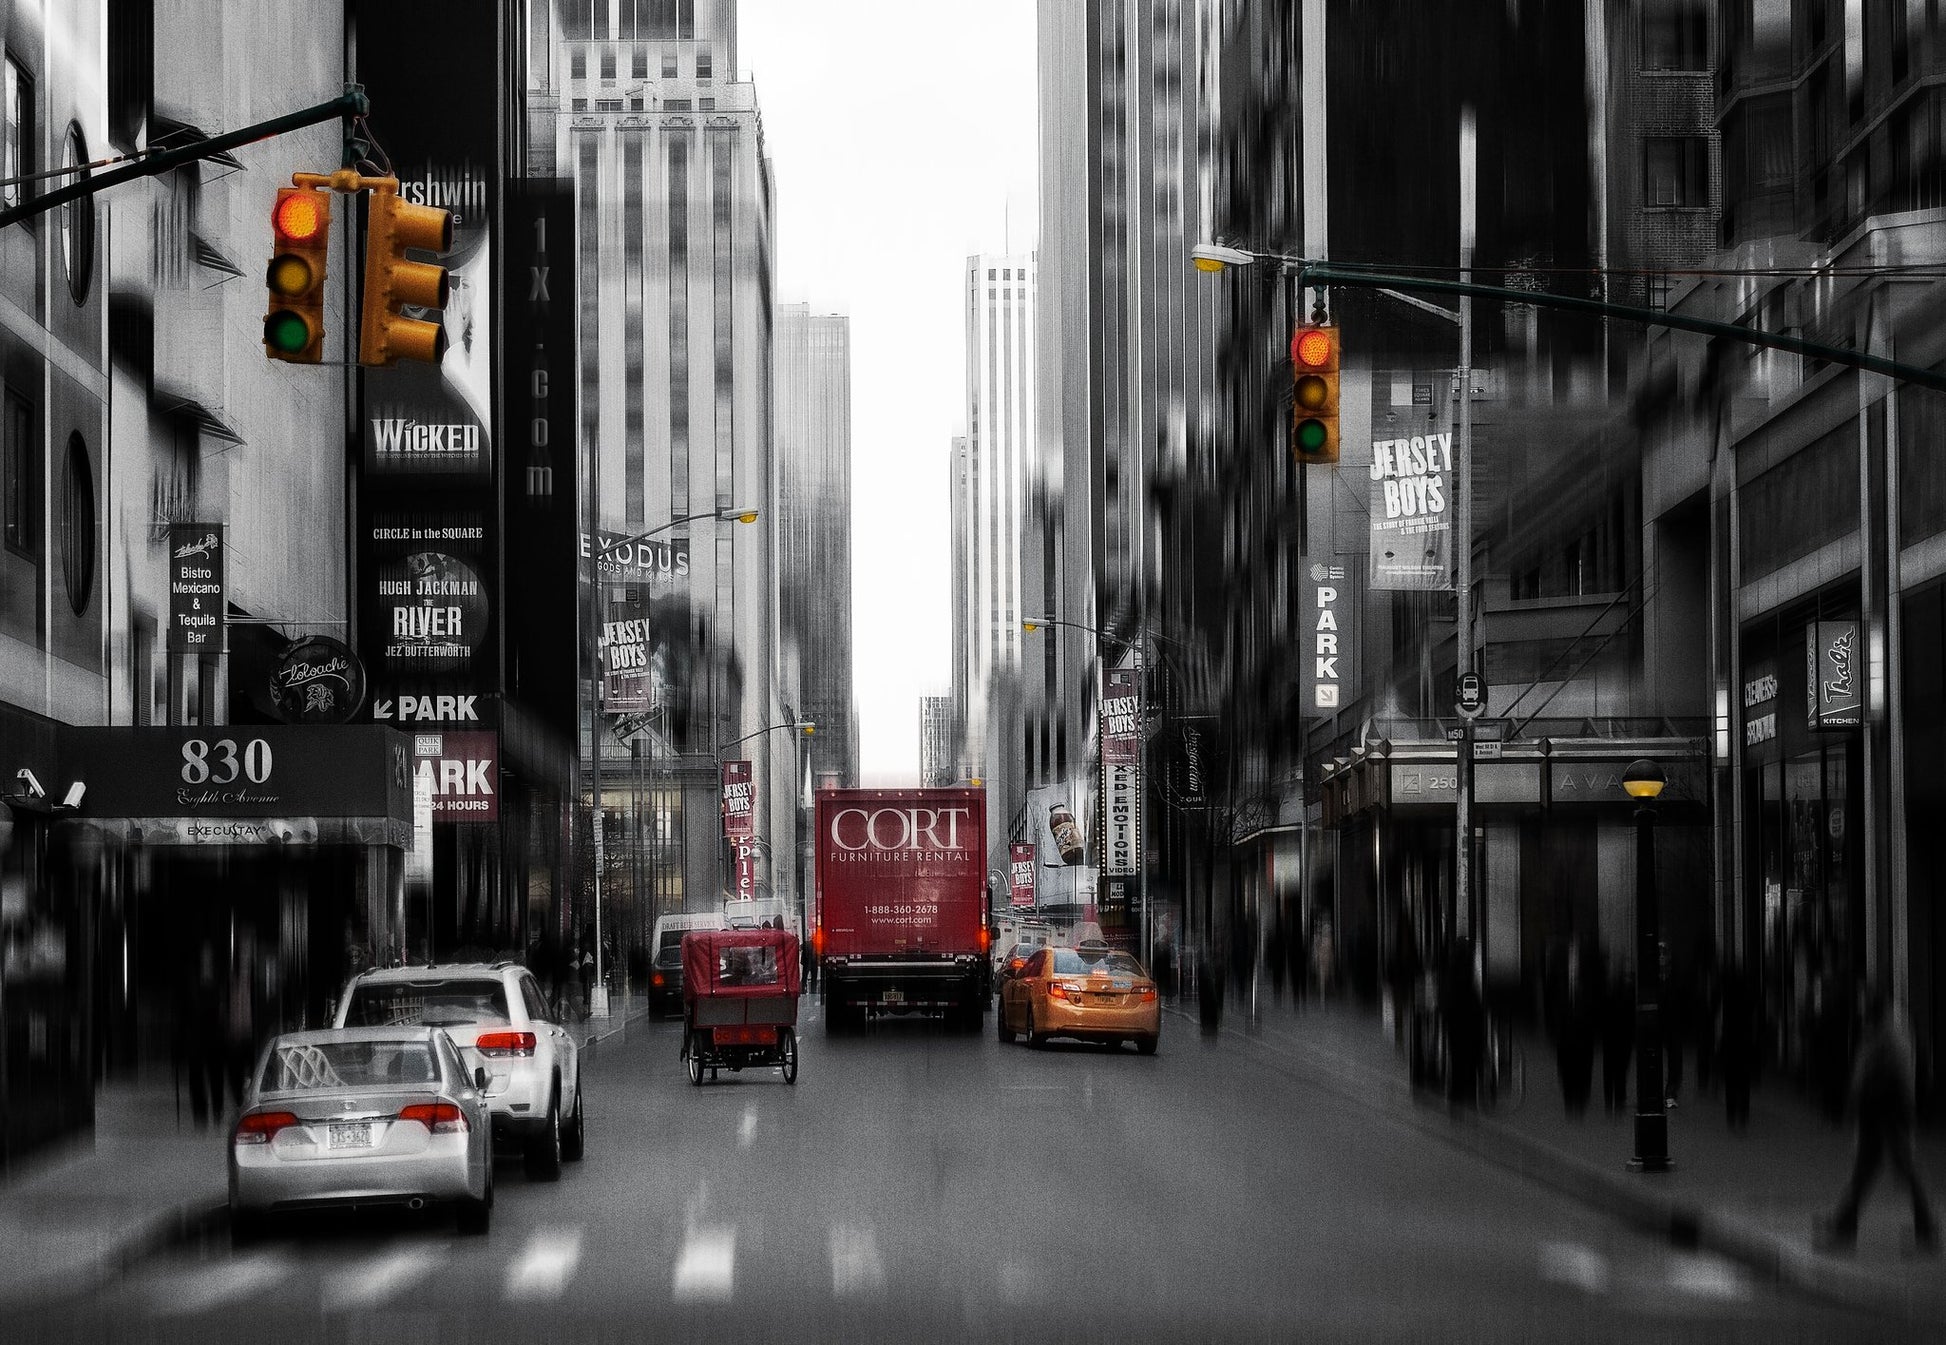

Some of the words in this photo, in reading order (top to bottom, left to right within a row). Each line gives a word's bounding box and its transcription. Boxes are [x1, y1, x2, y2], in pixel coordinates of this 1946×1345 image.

[392, 172, 486, 206] rshwin
[1370, 433, 1452, 481] JERSEY
[1383, 474, 1446, 518] BOYS
[373, 528, 410, 540] CIRCLE
[412, 528, 422, 539] in
[424, 528, 440, 539] the
[442, 527, 483, 540] SQUARE
[580, 532, 689, 576] EXODUS
[181, 567, 212, 579] Bistro
[598, 561, 620, 573] GODS
[173, 582, 220, 594] Mexicano
[379, 581, 411, 595] HUGH
[416, 581, 478, 596] JACKMAN
[193, 598, 201, 610] &
[178, 614, 216, 628] Tequila
[394, 606, 462, 636] RIVER
[187, 632, 207, 643] Bar
[602, 618, 650, 646] JERSEY
[1316, 587, 1339, 678] PARK
[385, 645, 402, 657] JEZ
[405, 645, 471, 657] BUTTERWORTH
[610, 642, 647, 669] BOYS
[1824, 626, 1856, 703] Thalia
[399, 696, 479, 721] PARK
[1102, 696, 1138, 716] JERSEY
[1108, 714, 1135, 734] BOYS
[1448, 729, 1464, 740] M50
[181, 739, 273, 784] 830
[415, 759, 494, 795] ARK
[1430, 776, 1457, 790] 250
[724, 782, 752, 798] JERSEY
[177, 788, 219, 808] Eighth
[222, 788, 280, 804] Avenue
[728, 797, 750, 812] BOYS
[431, 801, 444, 811] 24
[447, 801, 489, 811] HOURS
[831, 808, 970, 850] CORT
[1113, 797, 1129, 866] EMOTIONS
[831, 852, 909, 862] FURNITURE
[916, 851, 970, 862] RENTAL
[1012, 860, 1035, 873] JERSEY
[1015, 872, 1033, 885] BOYS
[864, 905, 938, 914] 1-888-360-2678
[662, 922, 680, 930] DRAFT
[871, 916, 932, 925] www.cort.com
